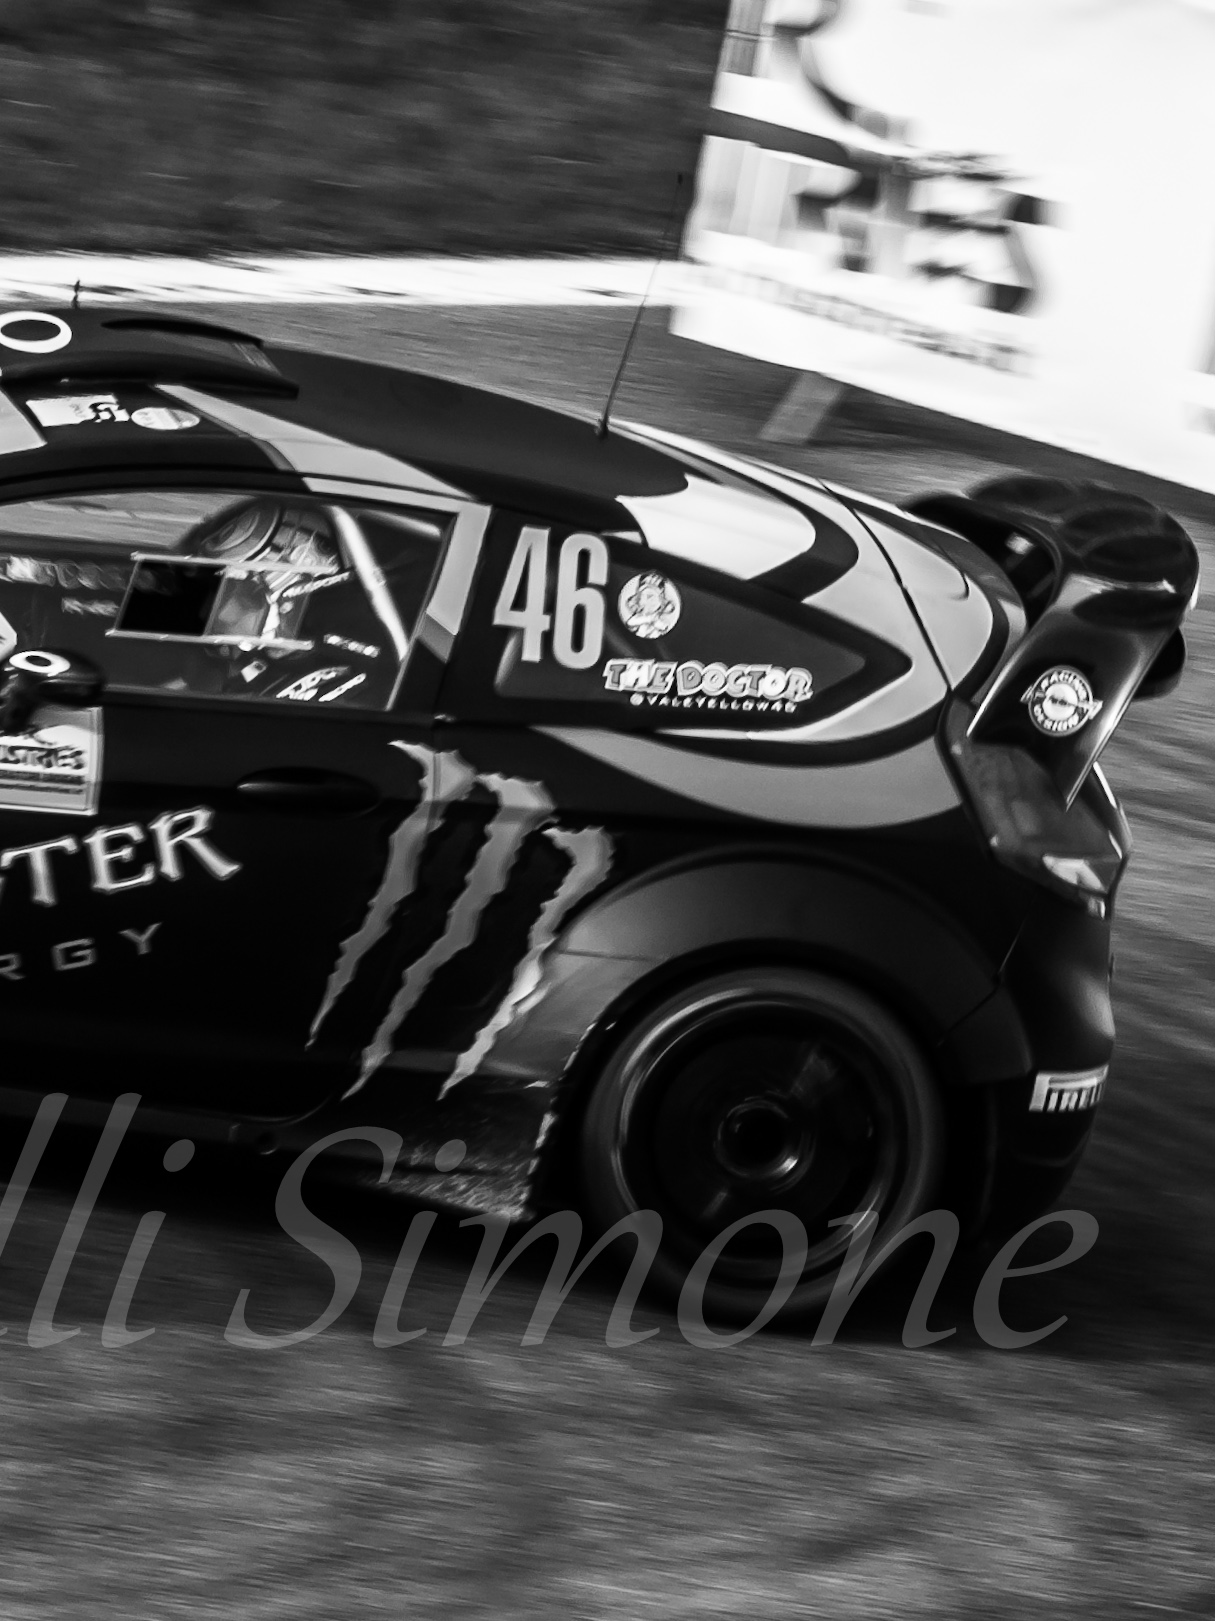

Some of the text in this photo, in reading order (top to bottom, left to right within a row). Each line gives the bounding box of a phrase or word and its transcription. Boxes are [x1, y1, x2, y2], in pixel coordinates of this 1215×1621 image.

[492, 525, 610, 670] 46
[603, 657, 814, 702] THE DOCTOR
